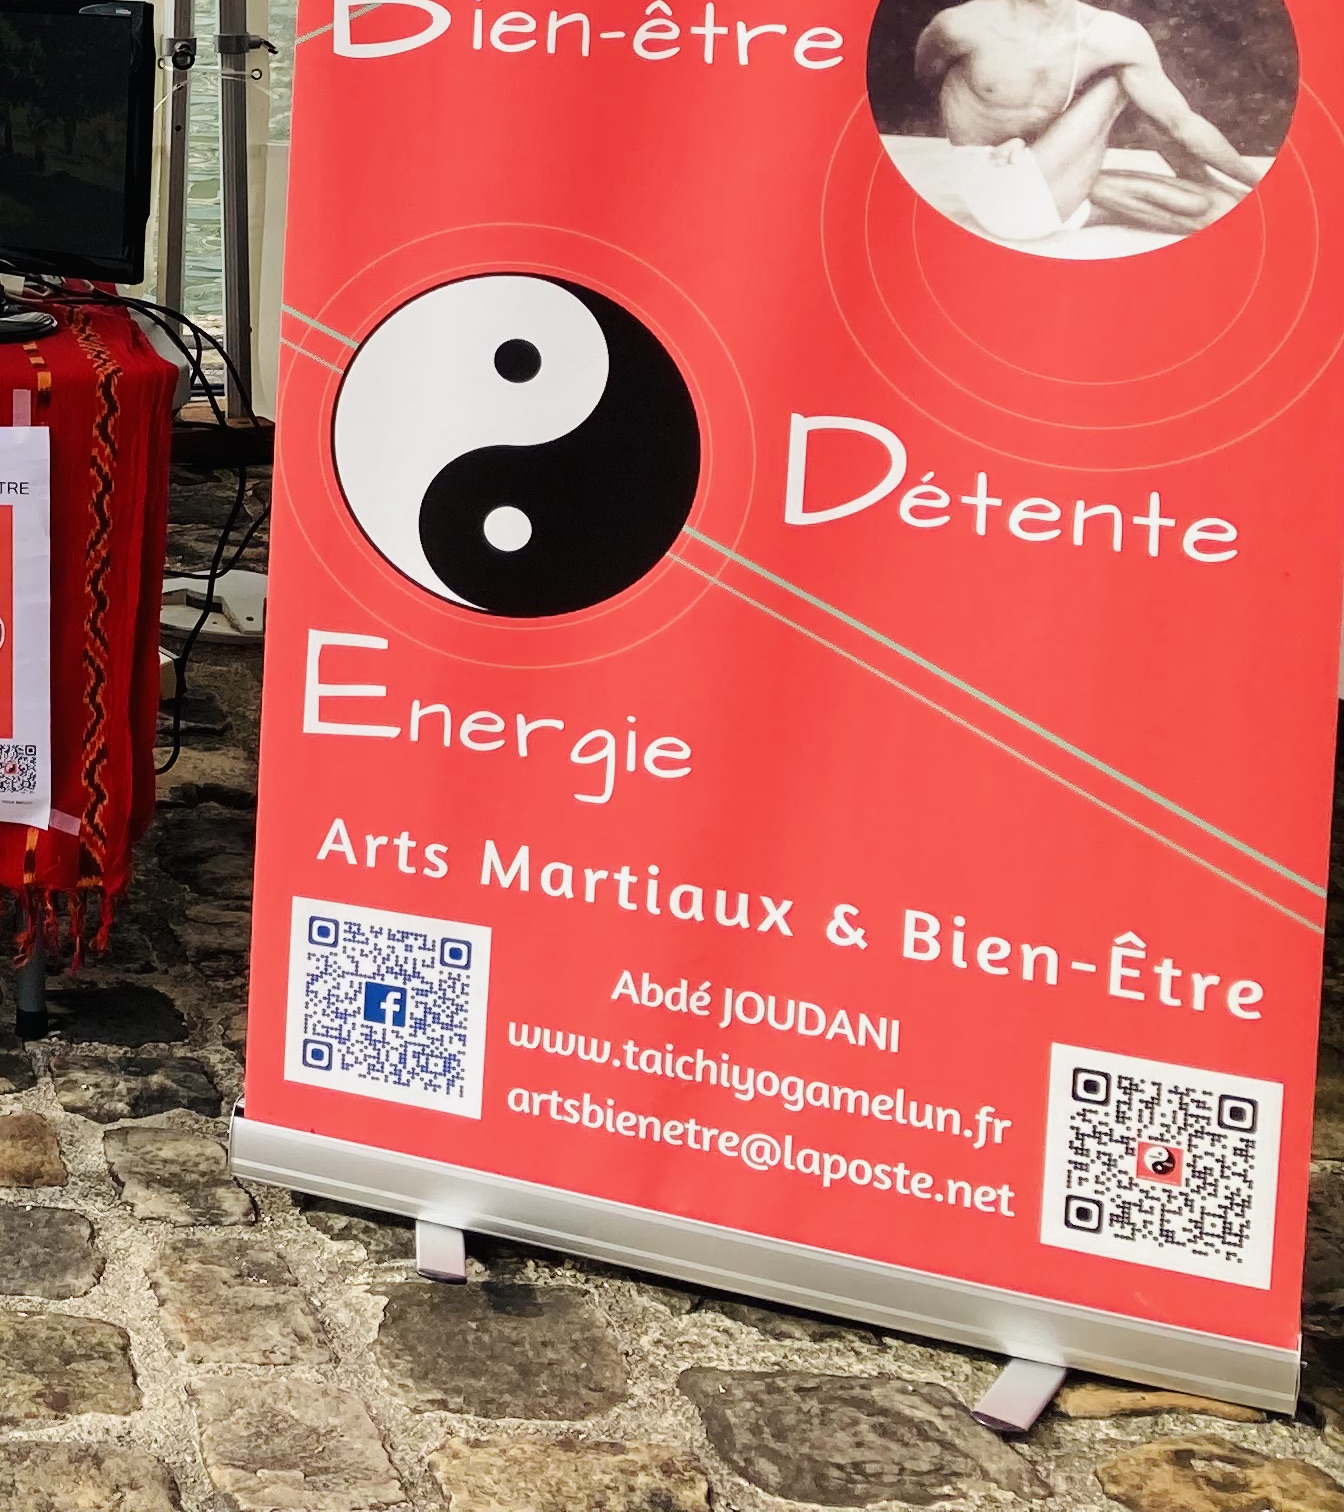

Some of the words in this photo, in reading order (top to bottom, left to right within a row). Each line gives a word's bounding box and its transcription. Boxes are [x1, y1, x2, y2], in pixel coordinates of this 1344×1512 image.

[784, 412, 1240, 565] Détente
[303, 627, 693, 805] Energie
[317, 818, 450, 880] Arts
[481, 842, 796, 938] Martiaux
[826, 902, 868, 954] &
[902, 909, 1266, 1022] Bien-Être
[507, 1016, 1012, 1146] www.taichiyogamelun.fr
[610, 969, 712, 1017] Abdé
[719, 987, 902, 1055] JOUDANI
[506, 1082, 1016, 1219] artsbienetre@laposte.net
